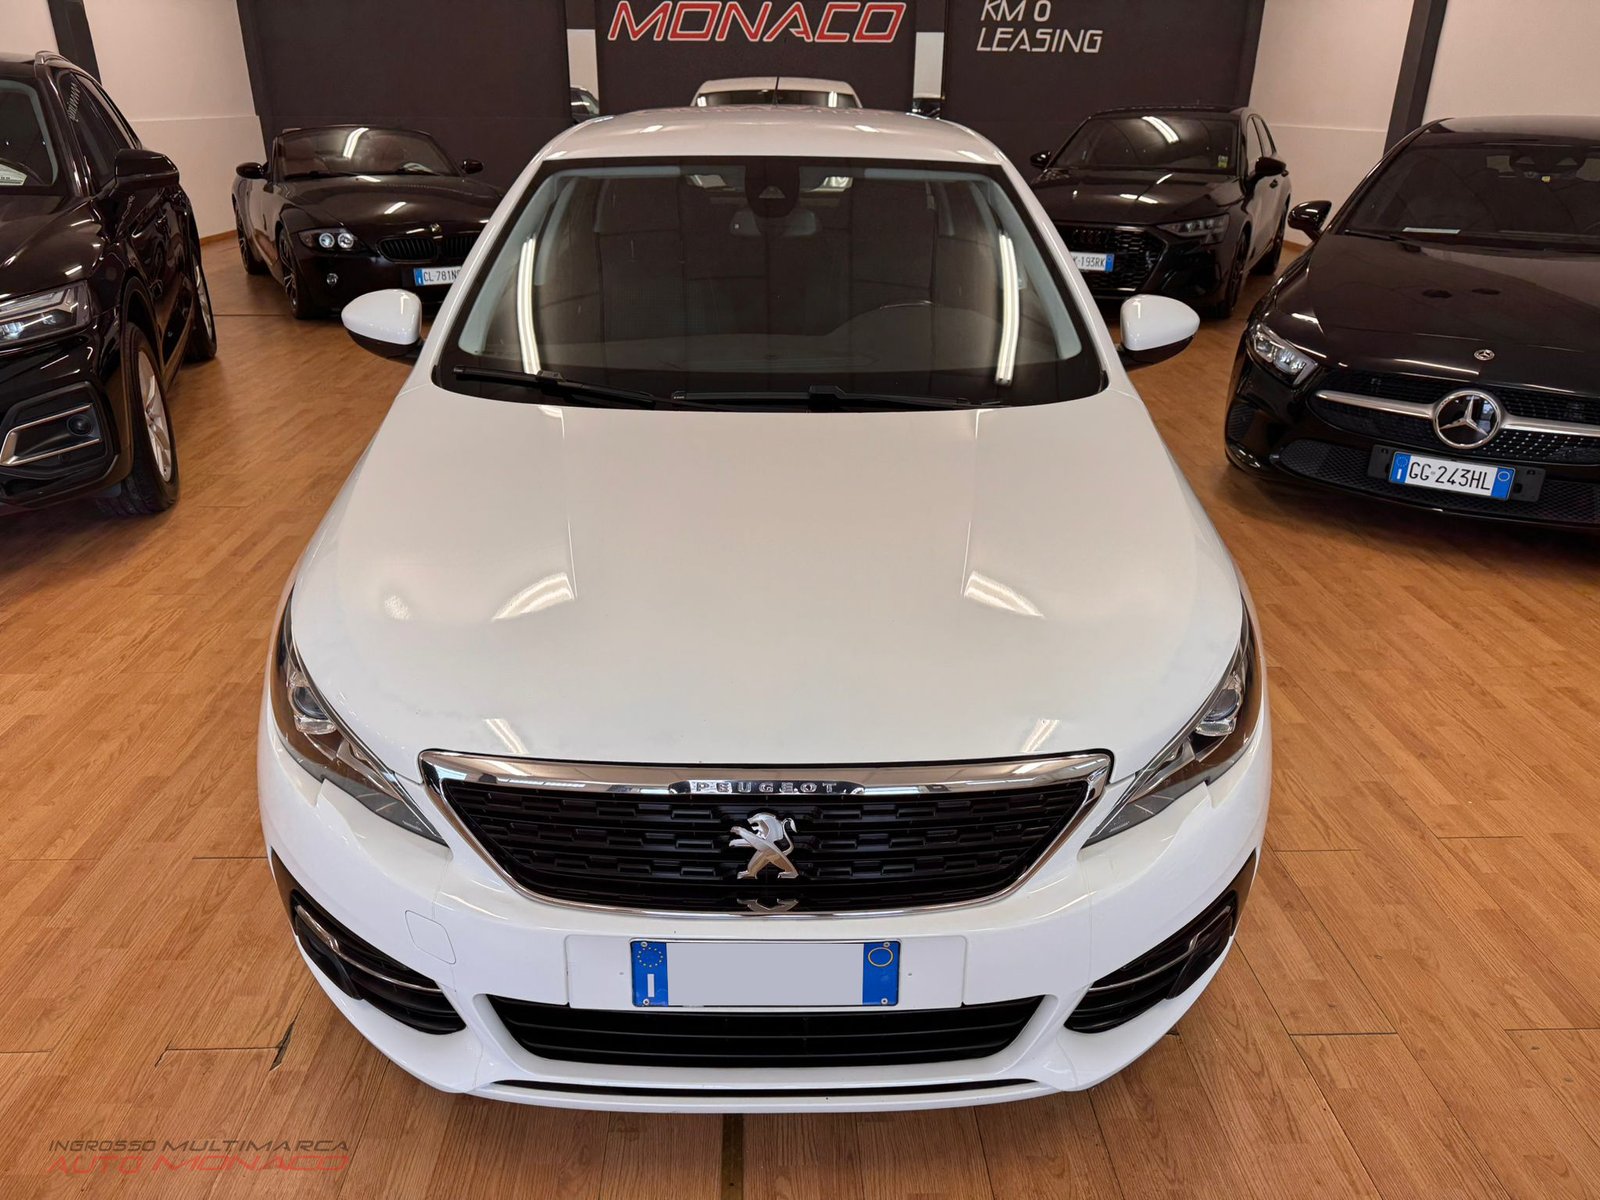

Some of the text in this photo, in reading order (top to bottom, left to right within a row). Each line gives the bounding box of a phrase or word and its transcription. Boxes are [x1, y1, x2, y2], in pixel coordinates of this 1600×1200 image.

[607, 0, 907, 42] MONACO
[980, 0, 1026, 21] KM
[976, 27, 1104, 53] LEASING
[1434, 465, 1491, 491] 243HL
[696, 782, 837, 793] PEUGEOT
